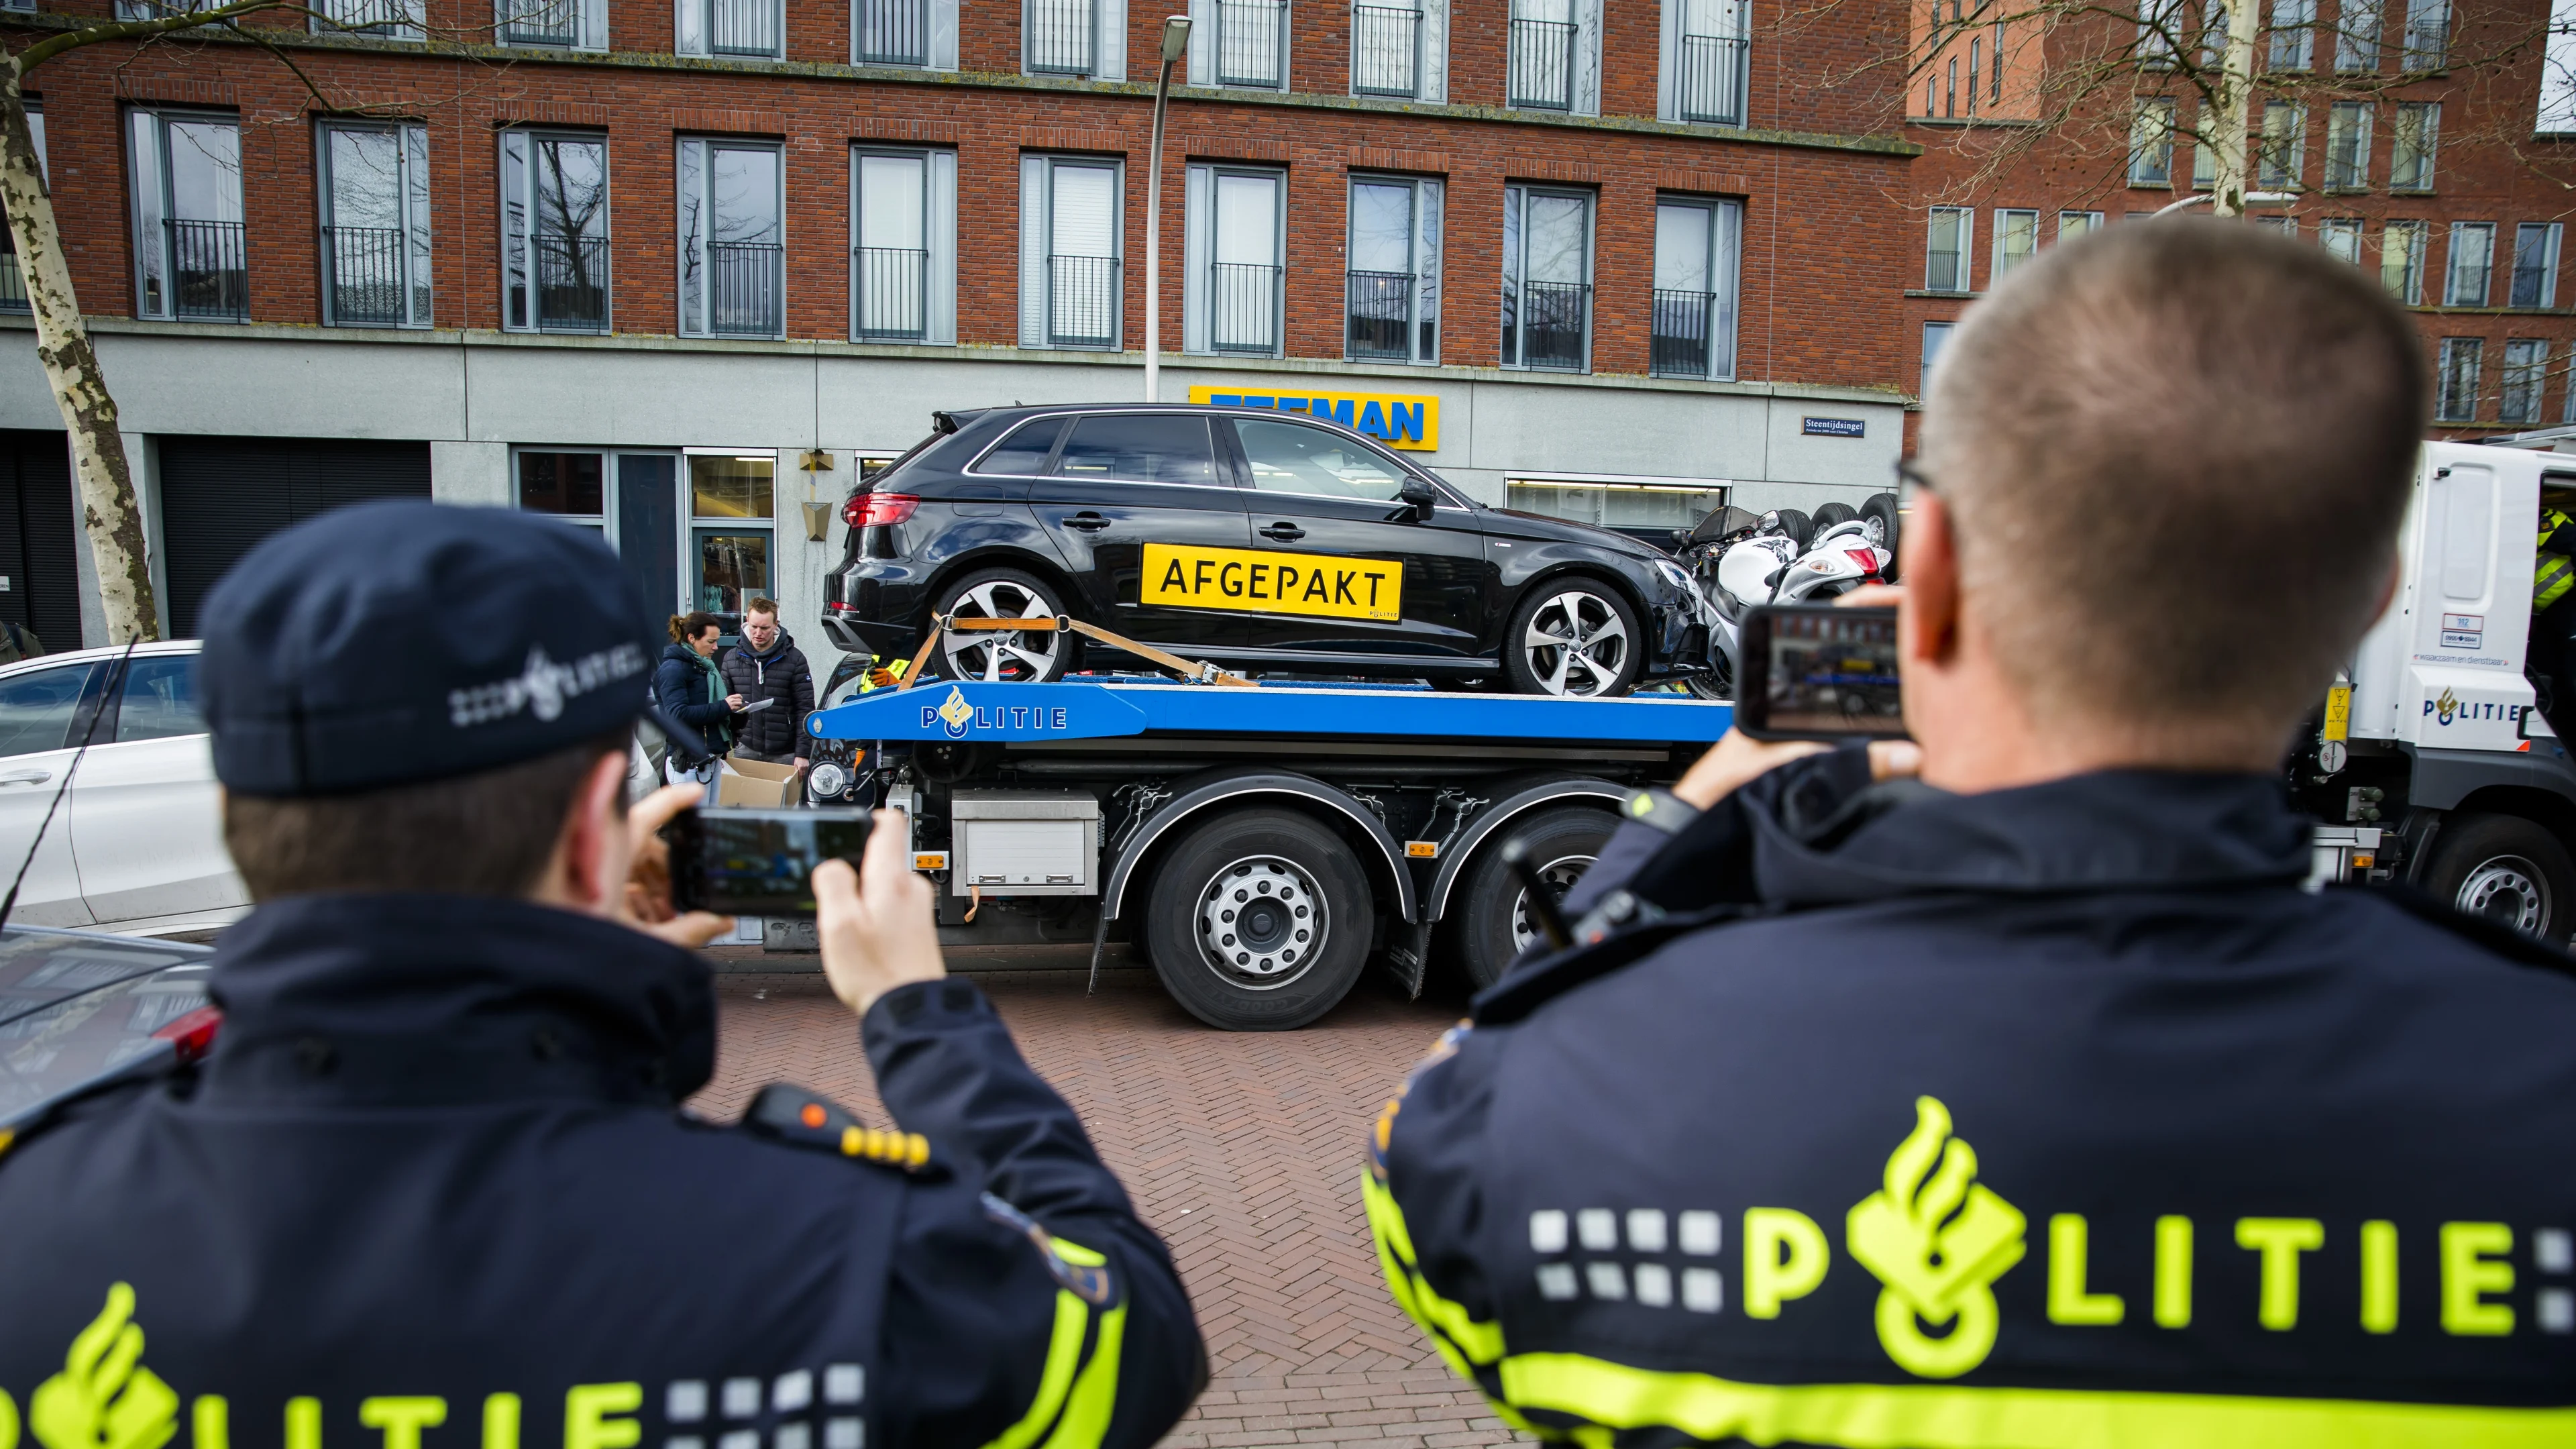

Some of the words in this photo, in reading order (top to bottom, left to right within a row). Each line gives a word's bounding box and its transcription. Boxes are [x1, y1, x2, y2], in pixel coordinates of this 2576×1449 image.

[1210, 394, 1424, 440] MAN
[1806, 419, 1863, 431] Steentijdsingel
[1160, 558, 1385, 606] AFGEPAKT
[1370, 608, 1397, 617] POLITIE
[2458, 618, 2469, 626] 112
[921, 684, 1067, 739] POLITIE
[2423, 685, 2520, 726] POLITIE
[1744, 1094, 2516, 1379] POLITIE
